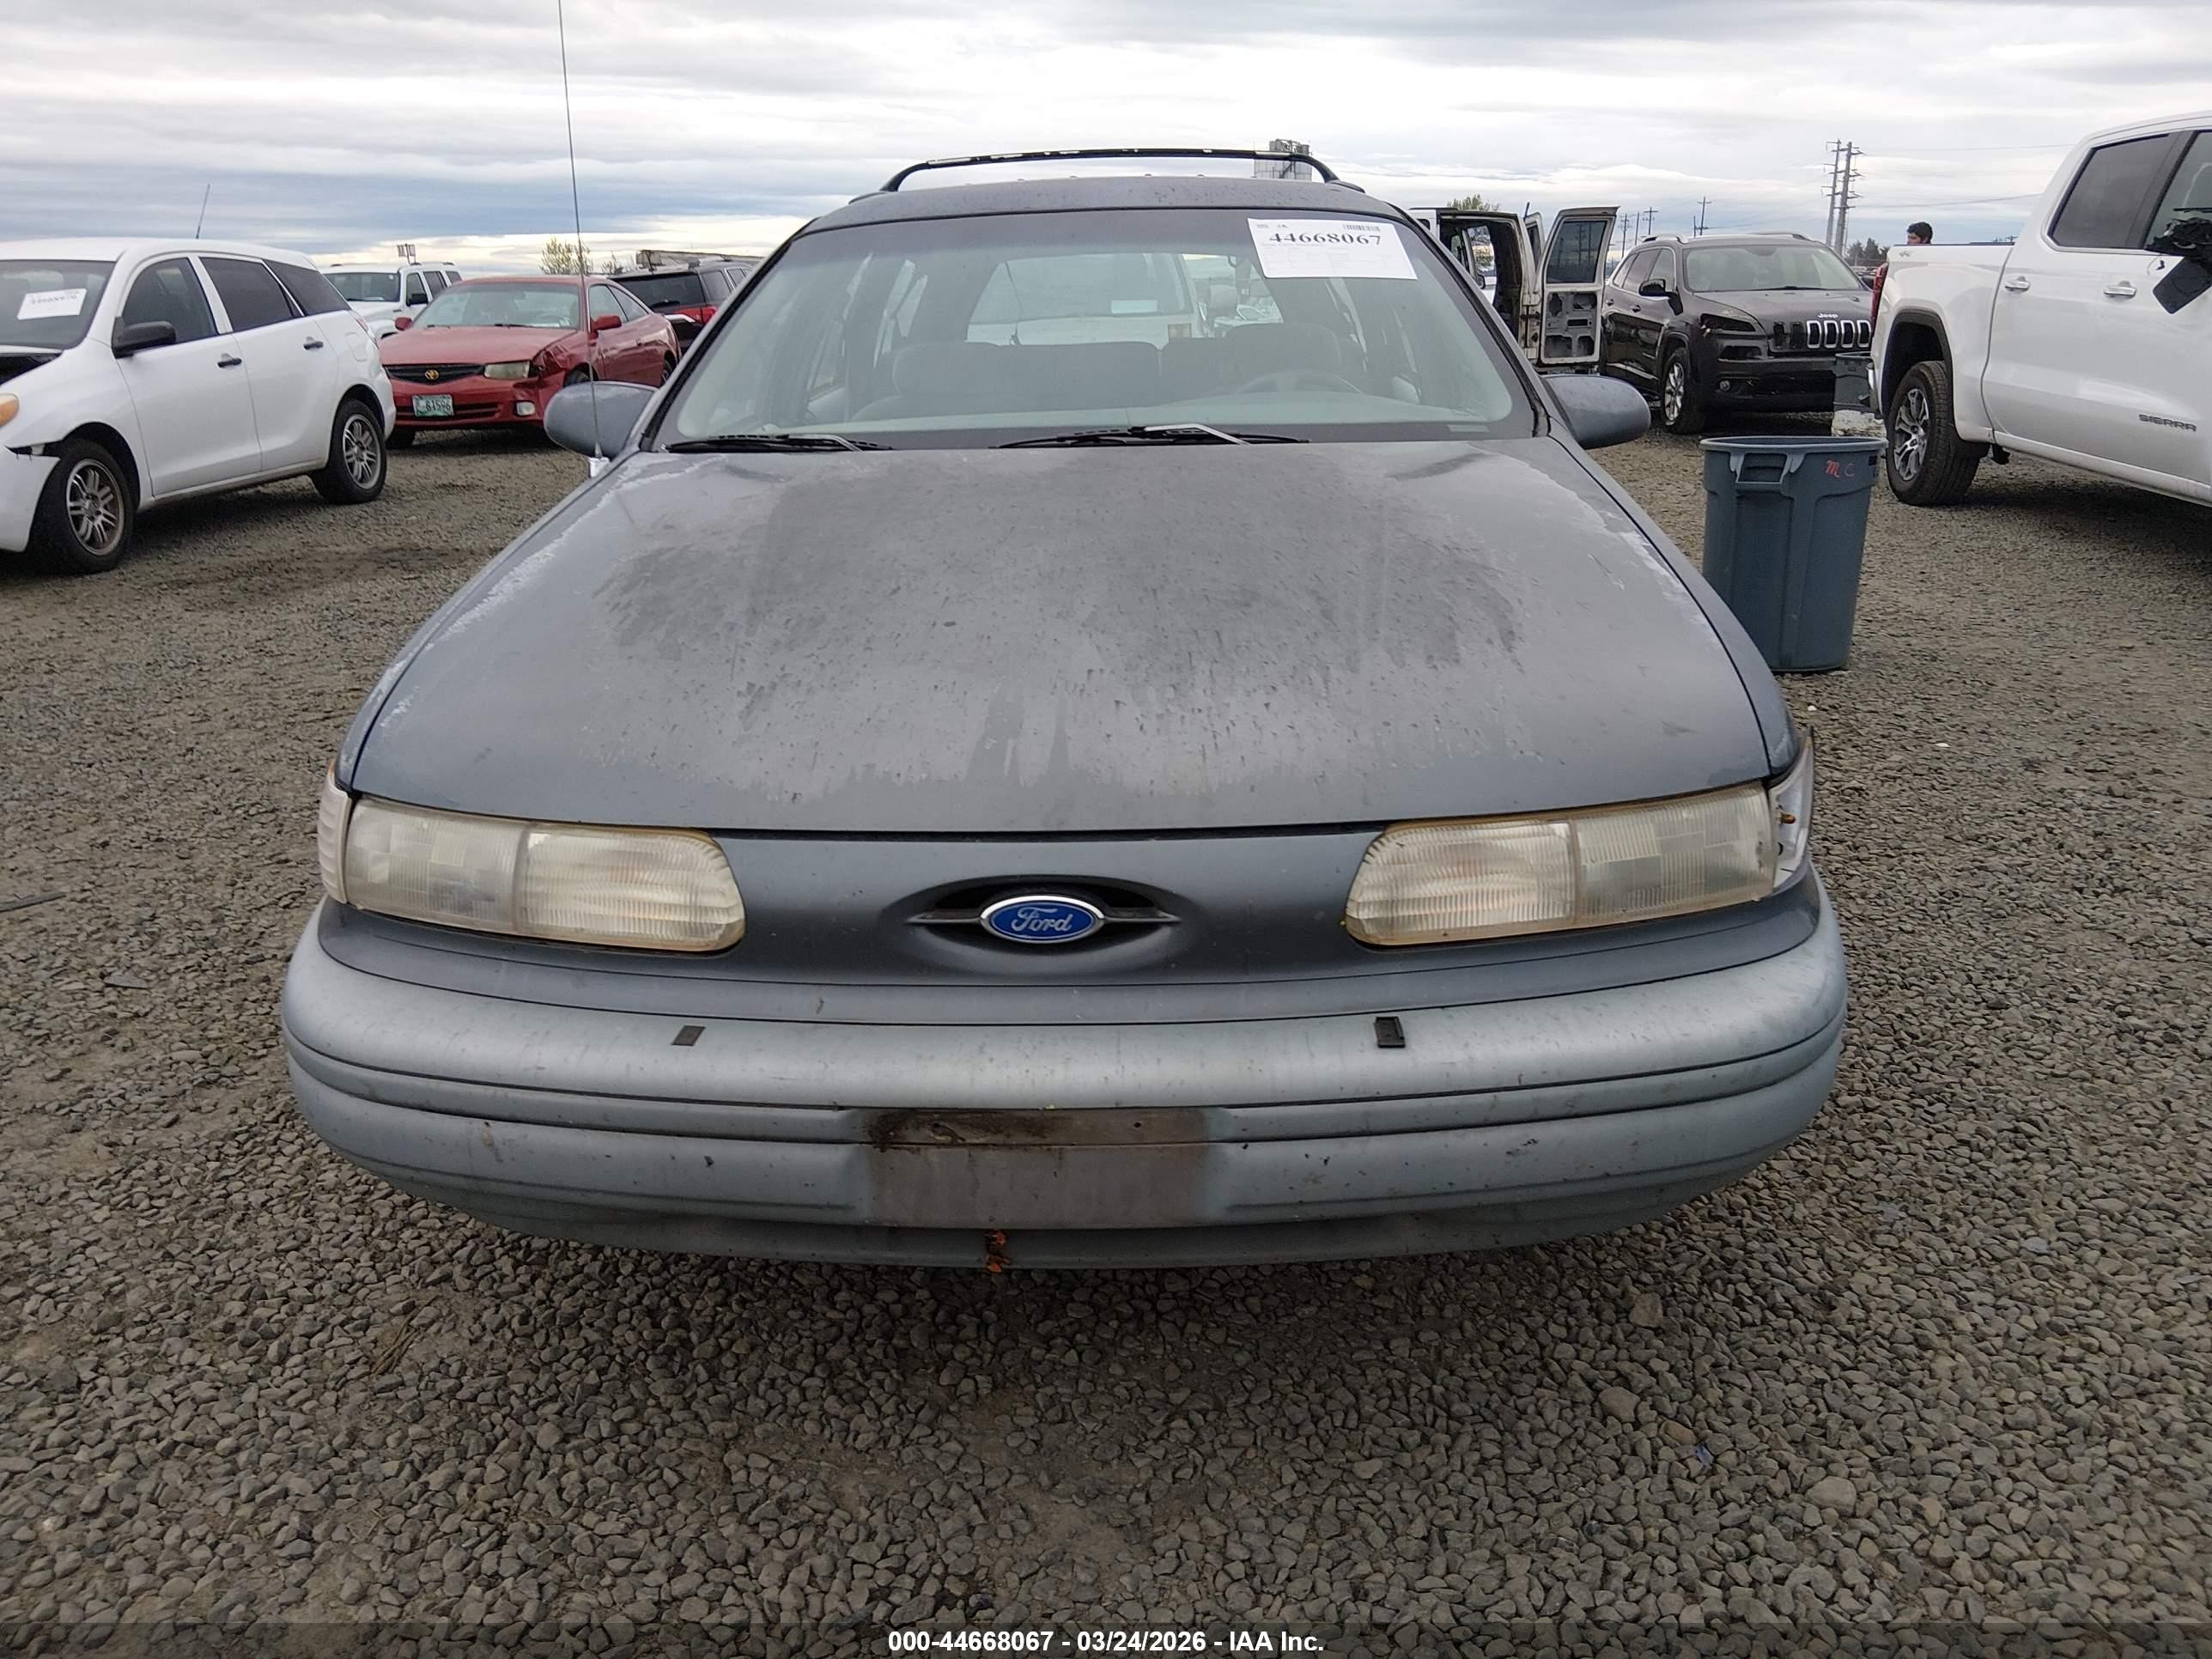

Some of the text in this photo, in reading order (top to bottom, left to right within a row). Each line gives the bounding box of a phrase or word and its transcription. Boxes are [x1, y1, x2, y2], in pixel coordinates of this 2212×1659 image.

[1269, 233, 1381, 246] 44668067
[2138, 414, 2197, 432] SIERRA
[1011, 906, 1073, 932] Ford
